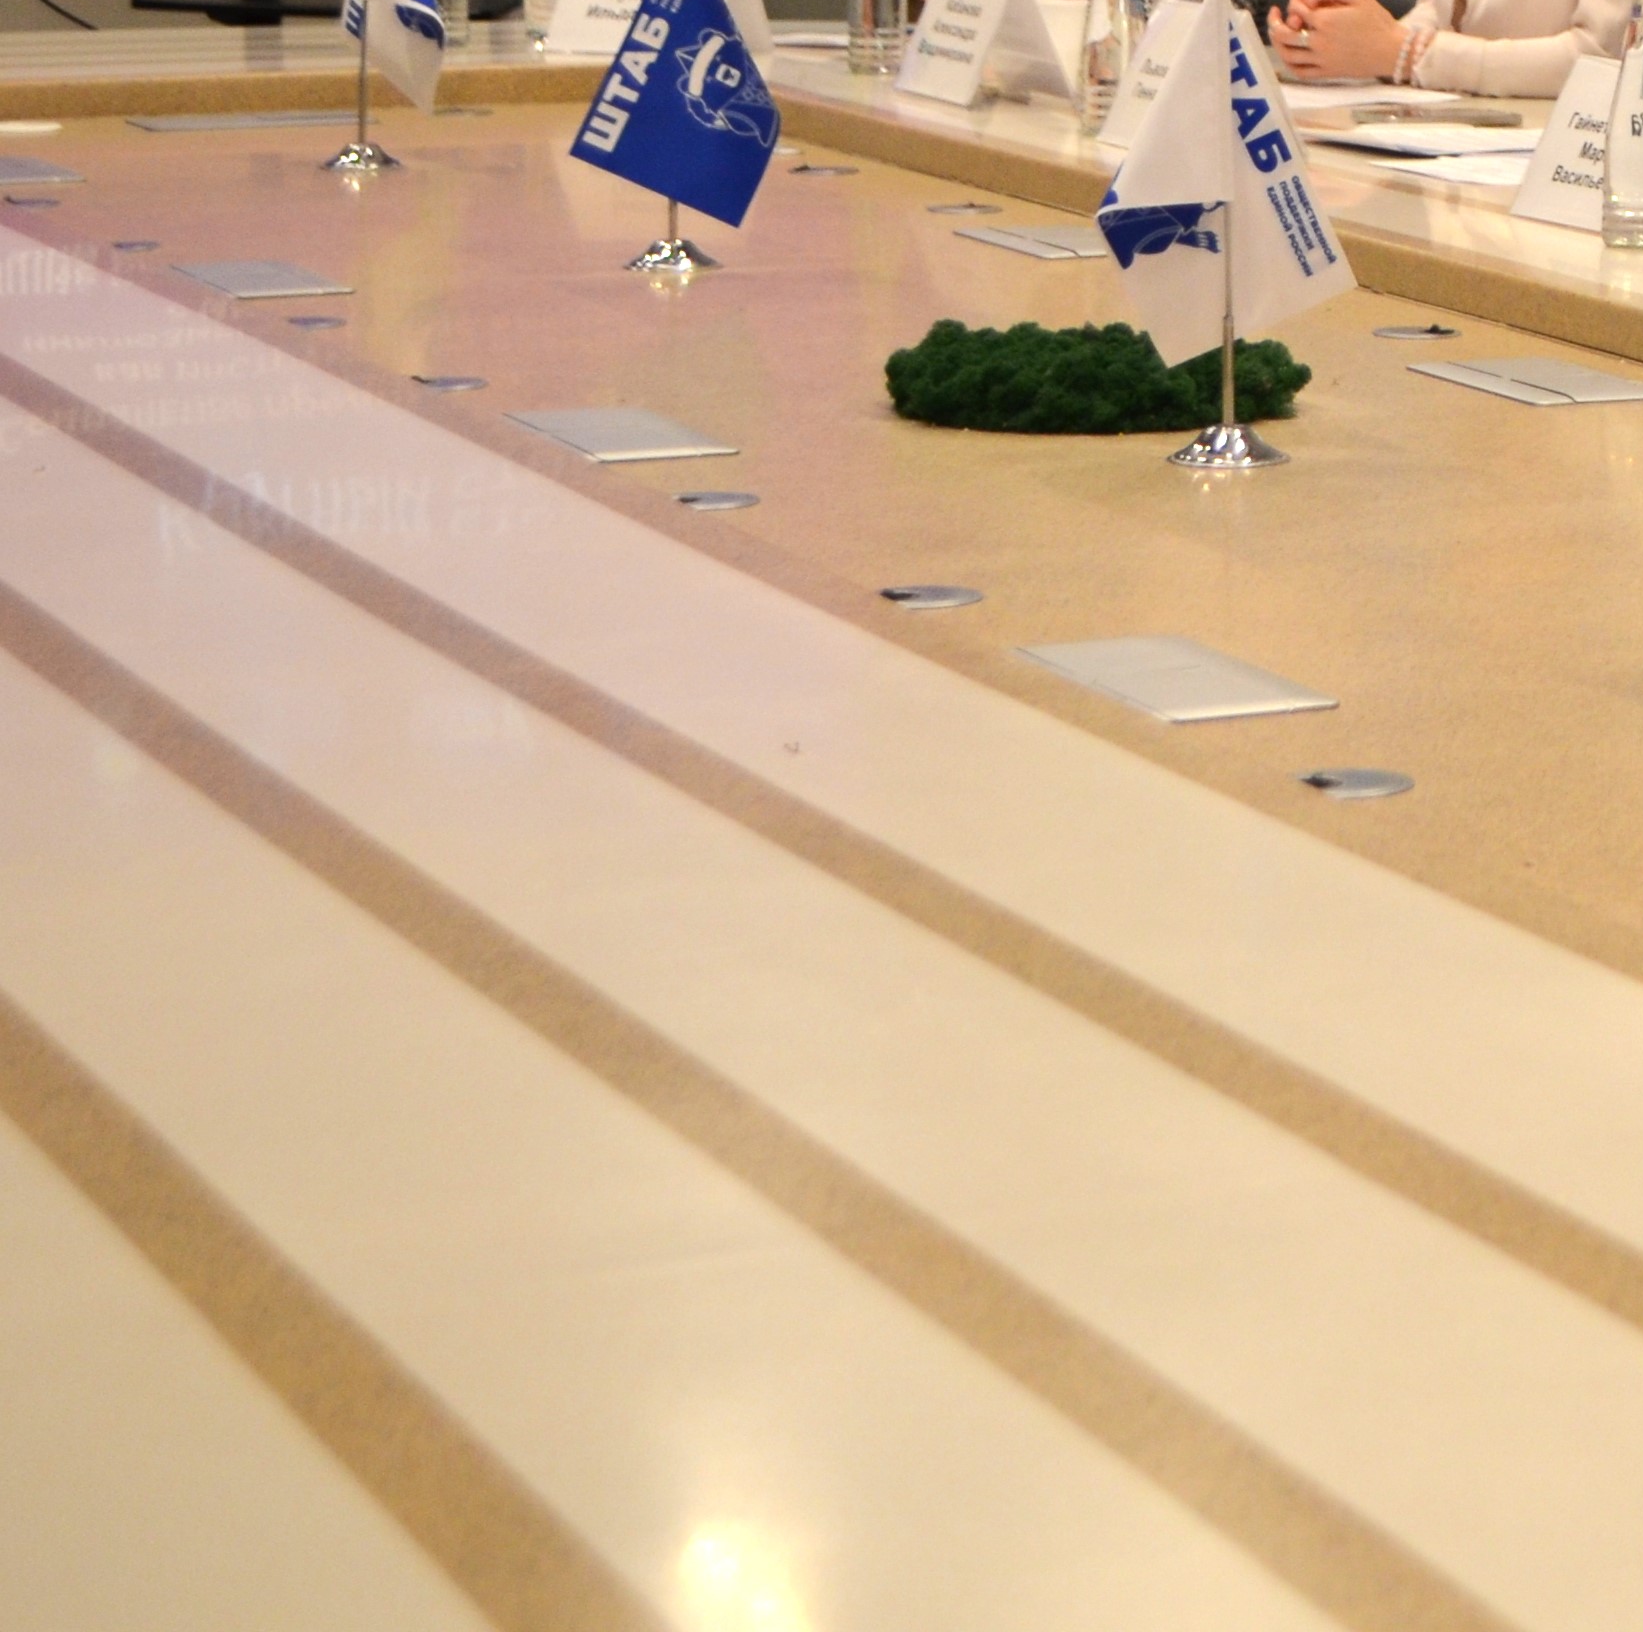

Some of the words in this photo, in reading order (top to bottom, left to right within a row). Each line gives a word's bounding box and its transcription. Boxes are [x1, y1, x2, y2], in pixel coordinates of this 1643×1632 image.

[581, 12, 671, 154] ШТАБ
[1578, 141, 1606, 166] Мар
[1551, 164, 1606, 191] Василье
